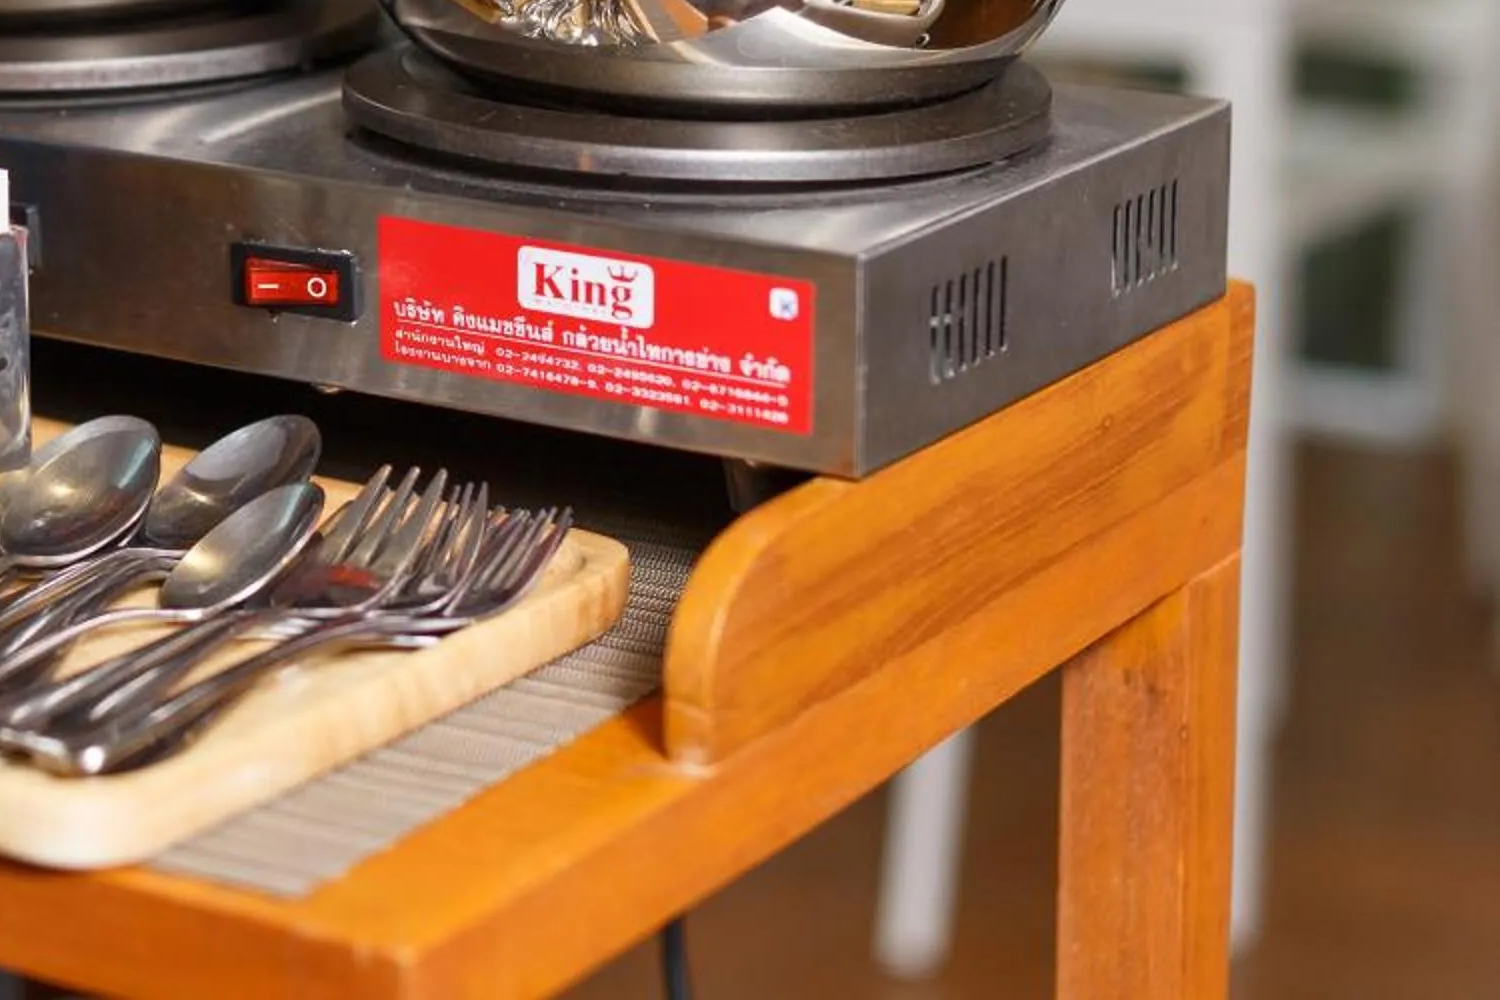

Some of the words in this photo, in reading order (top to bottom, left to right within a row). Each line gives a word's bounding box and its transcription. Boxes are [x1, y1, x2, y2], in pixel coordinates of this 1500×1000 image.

[393, 297, 445, 324] บริษัท
[533, 262, 634, 320] King
